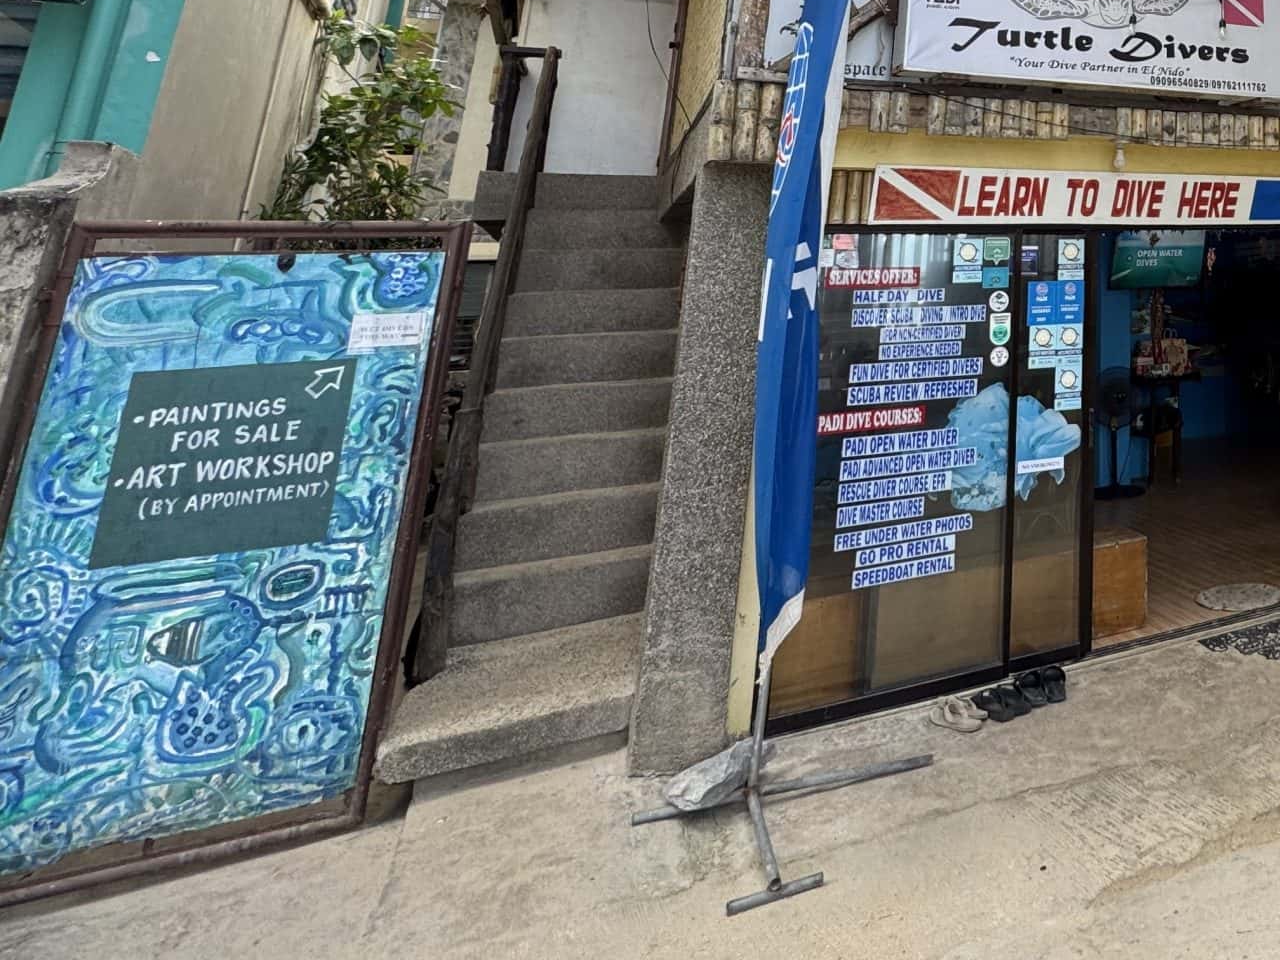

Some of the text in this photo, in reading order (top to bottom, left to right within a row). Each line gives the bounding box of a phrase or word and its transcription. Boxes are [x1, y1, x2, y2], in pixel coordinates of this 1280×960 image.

[948, 17, 1250, 64] Turtle Divers
[844, 63, 887, 78] space
[1048, 58, 1077, 71] Dive
[1080, 61, 1124, 74] Partner
[1127, 64, 1138, 74] in
[1140, 64, 1157, 75] El
[958, 176, 1241, 219] LEARN TO DIVE HERE
[1136, 258, 1158, 266] DIVES
[1137, 249, 1183, 258] OPEN WATER
[829, 268, 918, 286] SERVICES OFFER:
[855, 289, 943, 303] HALF DAY DIVE
[853, 310, 888, 326] DISCOVER
[891, 309, 913, 324] SCUBA
[920, 308, 944, 322] DIVING
[950, 306, 968, 322] INTRO
[970, 306, 986, 320] DIVE
[899, 327, 942, 340] NON-CERTIFIED
[882, 342, 960, 358] NO EXPERIENCE NEEDED
[852, 365, 868, 381] FUN
[871, 364, 889, 380] DIVE
[912, 360, 950, 378] CERTIFIED
[850, 386, 880, 404] SCUBA
[148, 397, 288, 428] PAINTINGS
[818, 408, 922, 432] PADI DIVE COURSES:
[170, 420, 302, 452] FOR SALE
[844, 429, 958, 456] PADI OPEN WATER DIVER
[126, 451, 334, 490] ART WORKSHOP
[842, 449, 975, 478] PADI ADVANCED OPEN WATER DIVER
[138, 480, 330, 520] (BY APPOINTMENT)
[840, 481, 871, 502] RESCUE
[873, 478, 896, 497] DIVER
[838, 498, 922, 526] DIVE MASTER COURSE
[836, 515, 971, 550] FREE UNDER WATER PHOTOS
[859, 538, 949, 566] GO PRO RENTAL
[854, 557, 952, 587] SPEEDBOAT RENTAL
